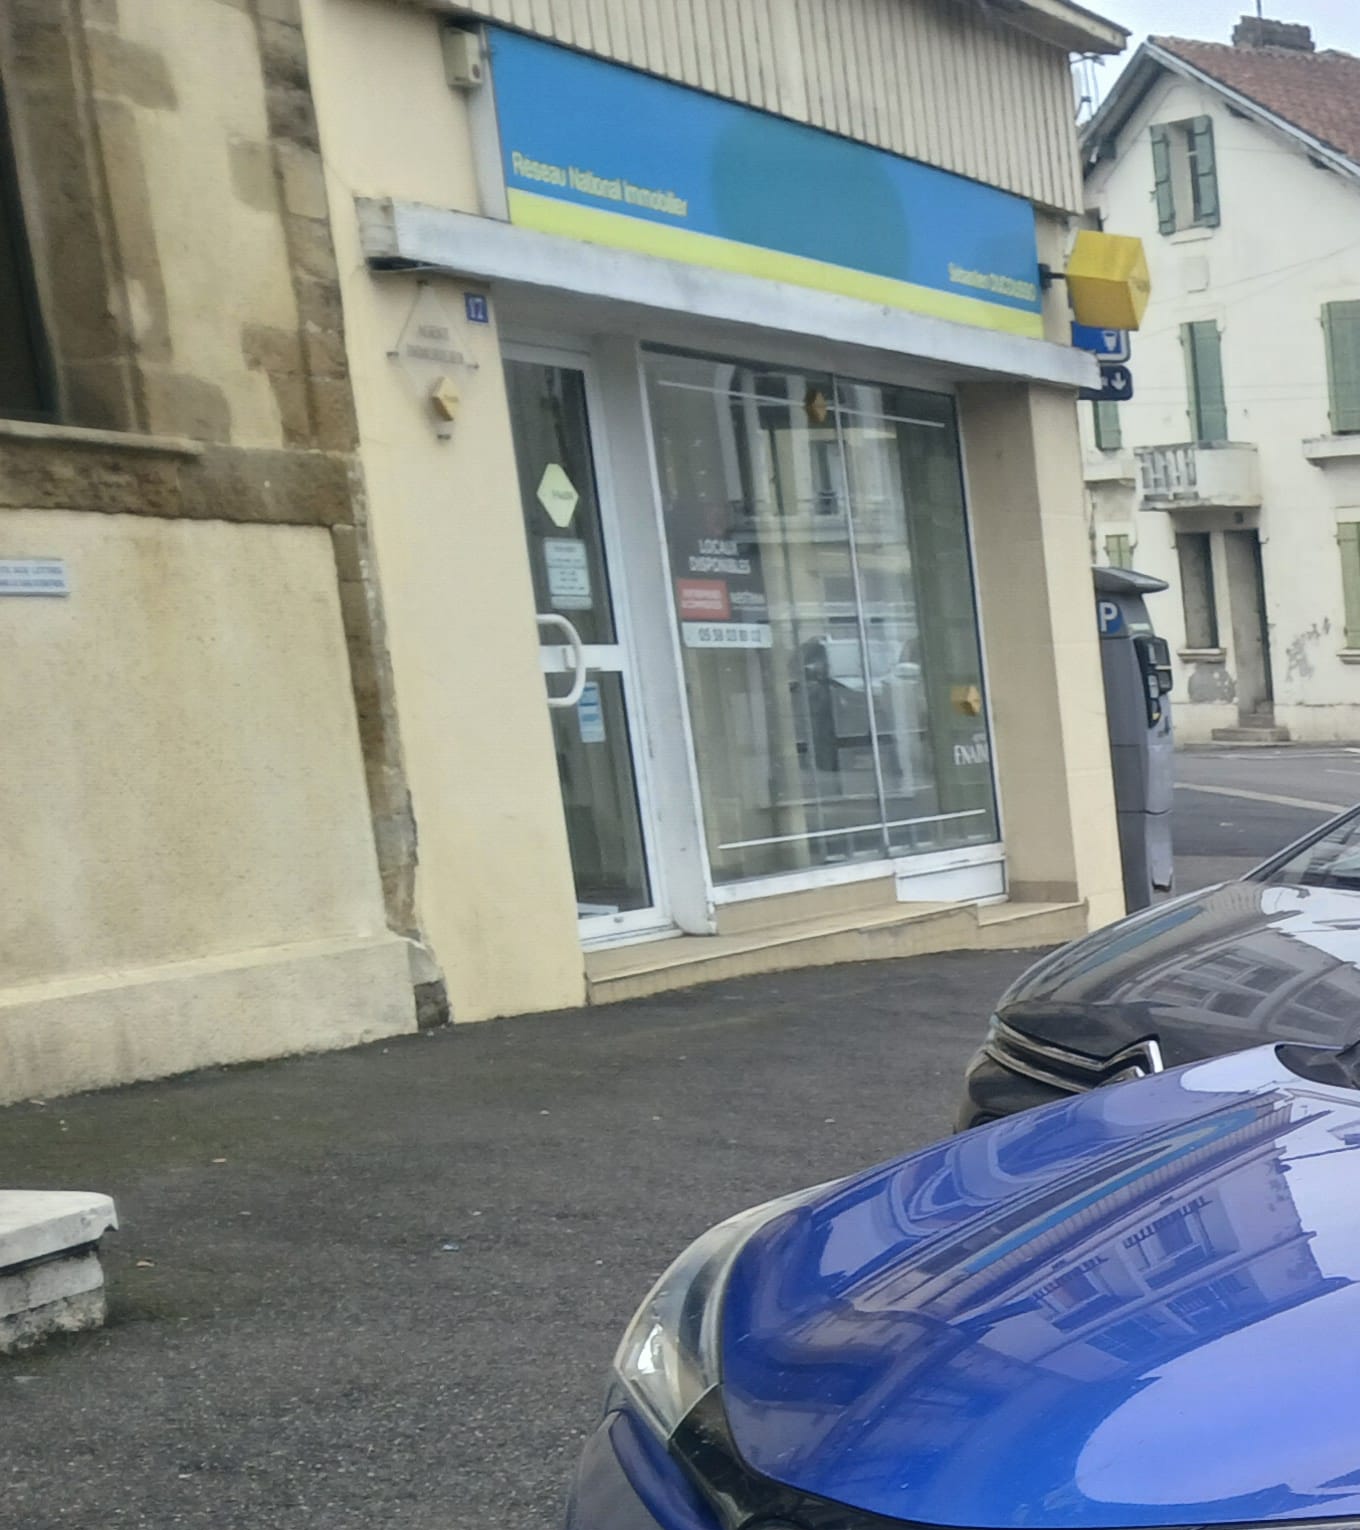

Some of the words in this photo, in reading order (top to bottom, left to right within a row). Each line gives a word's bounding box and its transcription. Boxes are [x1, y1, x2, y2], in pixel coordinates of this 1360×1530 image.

[568, 165, 623, 201] National
[624, 179, 688, 217] Immobilier
[468, 297, 484, 320] 17
[698, 539, 739, 556] LOCAUX
[1099, 602, 1118, 632] P
